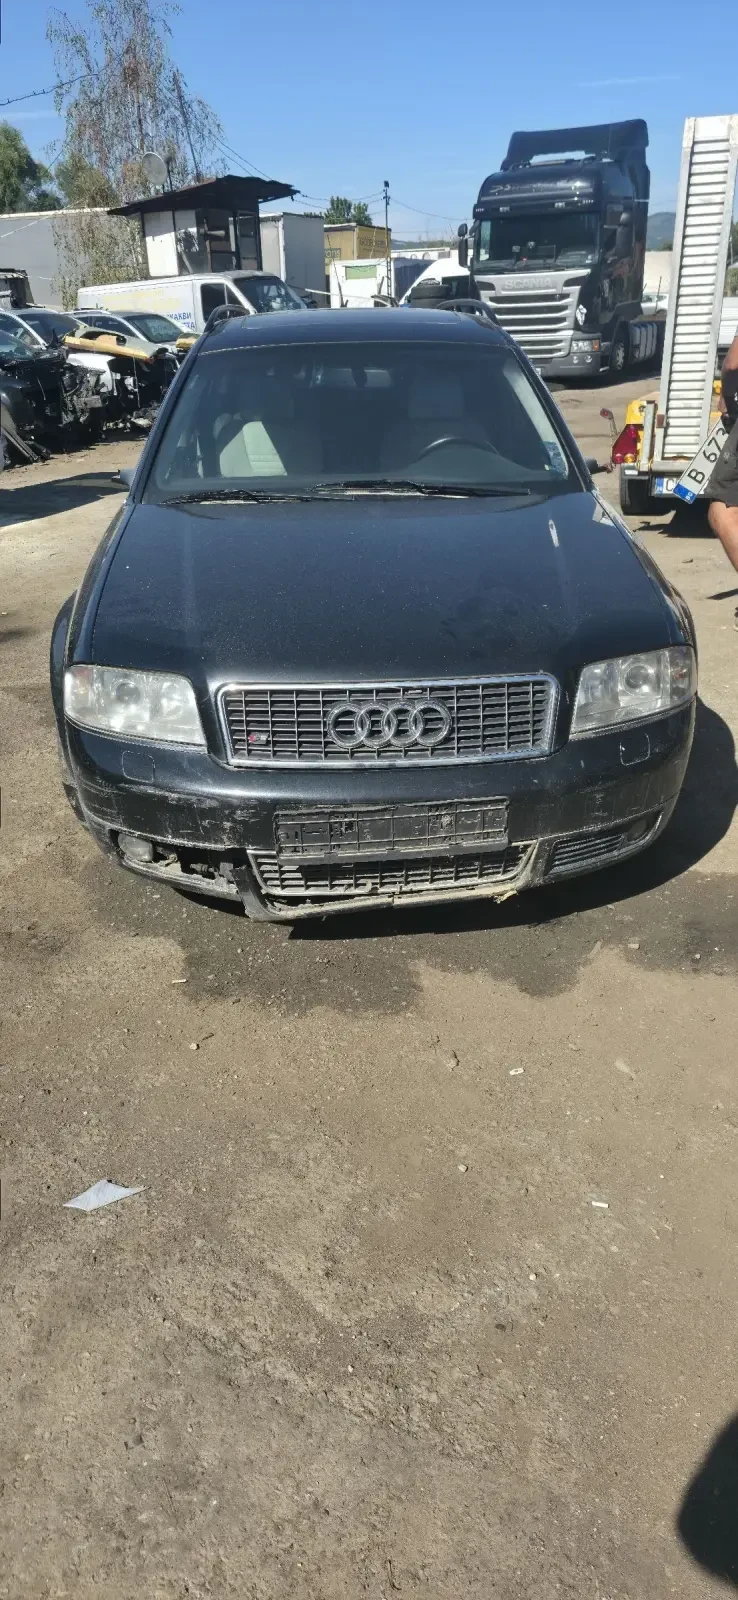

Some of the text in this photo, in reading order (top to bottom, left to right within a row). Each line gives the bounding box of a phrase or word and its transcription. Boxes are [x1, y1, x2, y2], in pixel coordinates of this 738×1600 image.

[325, 249, 340, 258] ans
[504, 278, 552, 289] SCANIA
[687, 468, 706, 485] B
